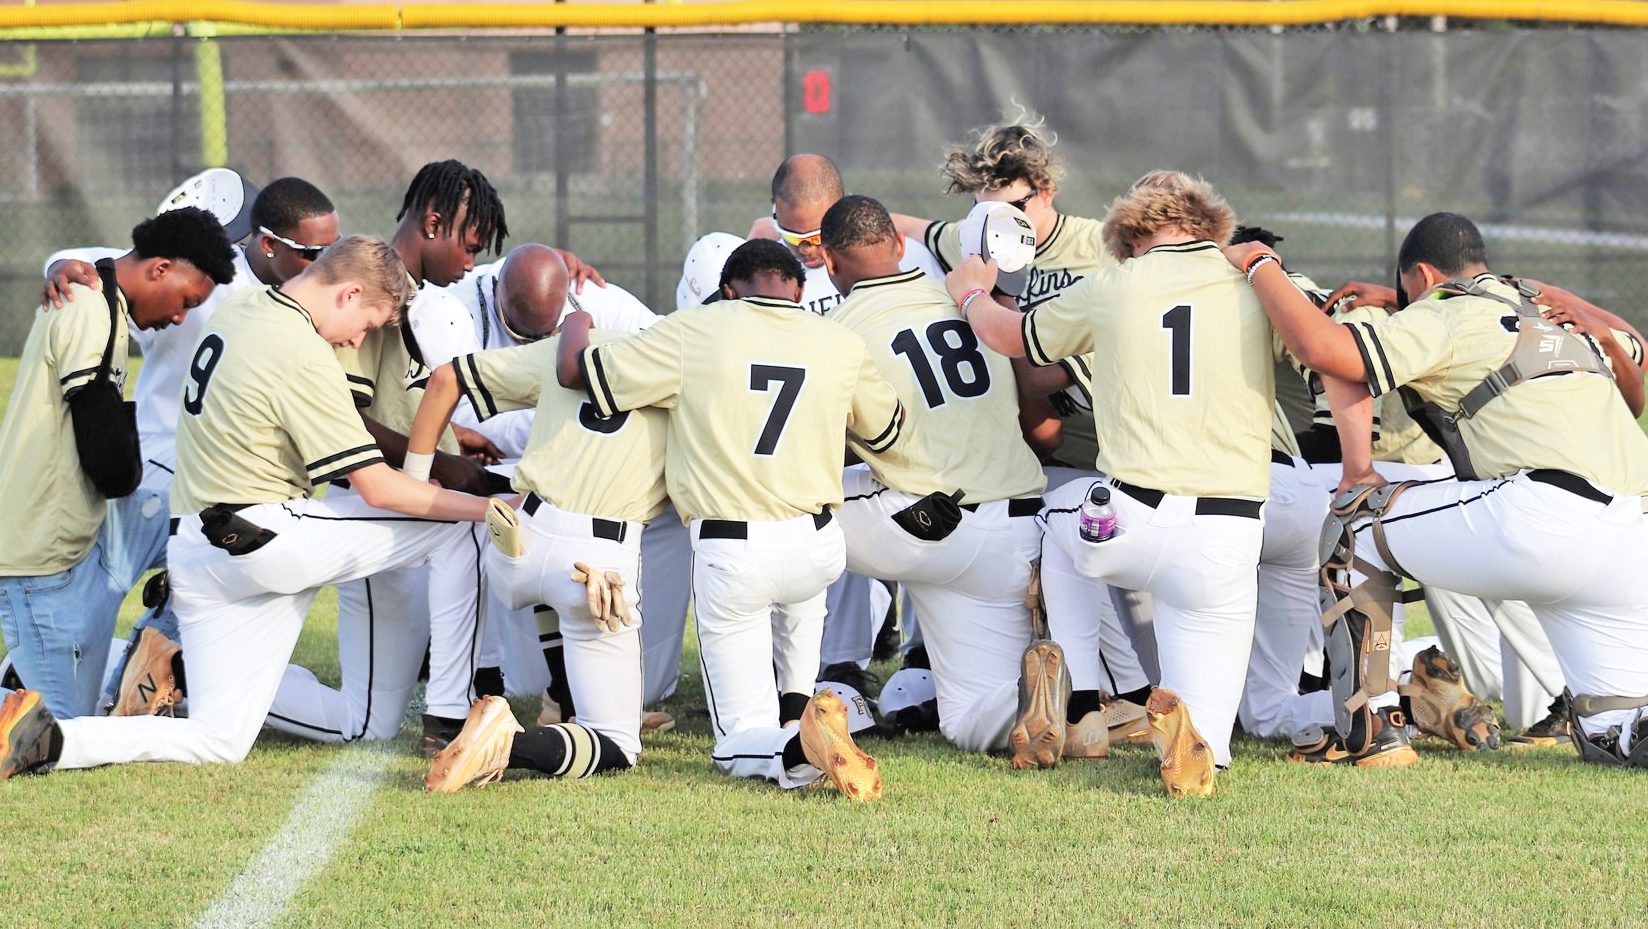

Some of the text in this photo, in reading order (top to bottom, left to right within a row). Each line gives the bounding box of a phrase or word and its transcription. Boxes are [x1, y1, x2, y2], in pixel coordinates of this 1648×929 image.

[184, 333, 224, 416] 9
[890, 319, 991, 409] 18
[1162, 304, 1191, 395] 1
[749, 363, 805, 455] 7
[138, 672, 157, 703] N
